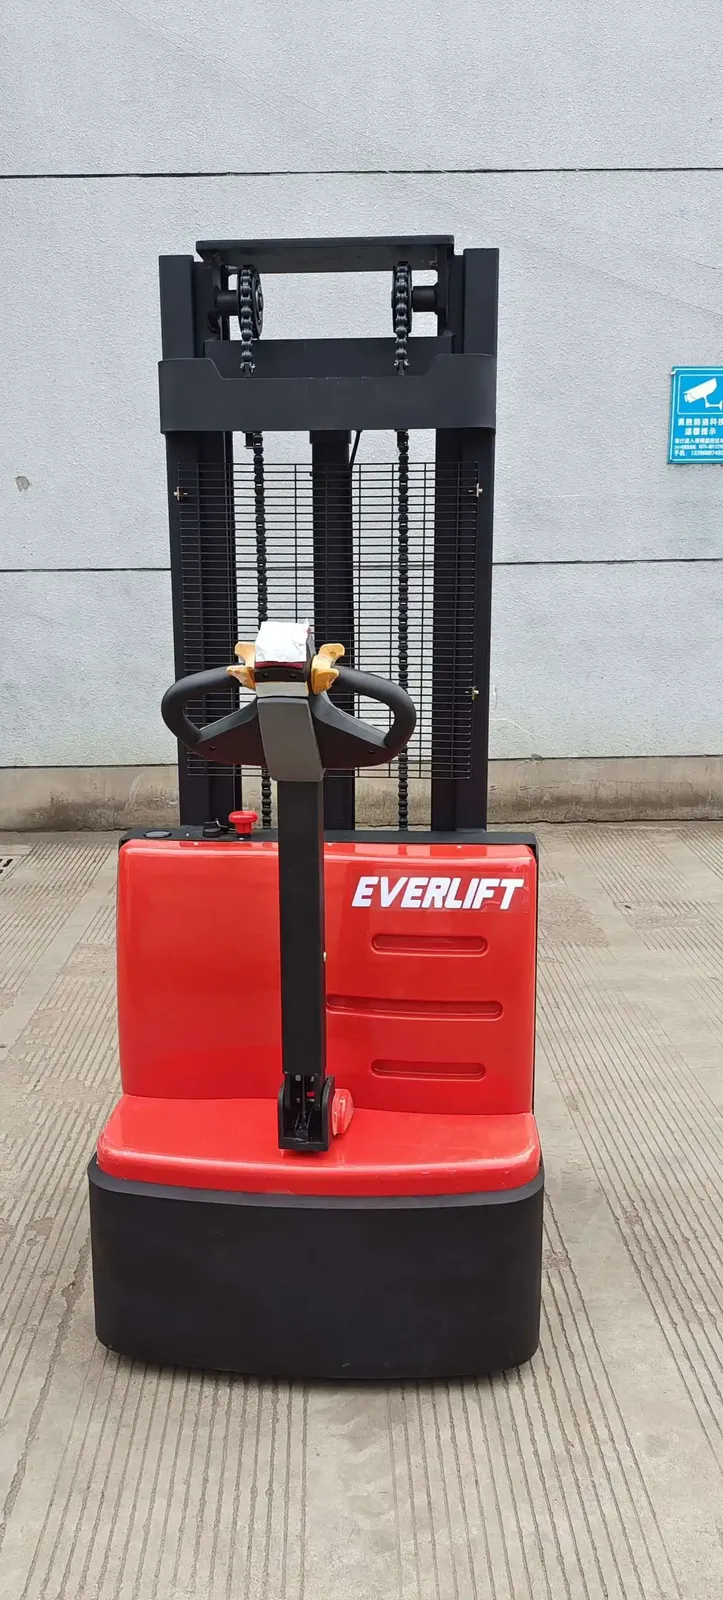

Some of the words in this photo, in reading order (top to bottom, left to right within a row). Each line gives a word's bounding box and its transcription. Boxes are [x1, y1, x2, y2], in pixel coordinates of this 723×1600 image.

[685, 428, 716, 436] 温馨提示
[351, 876, 524, 910] EVERLIFT
